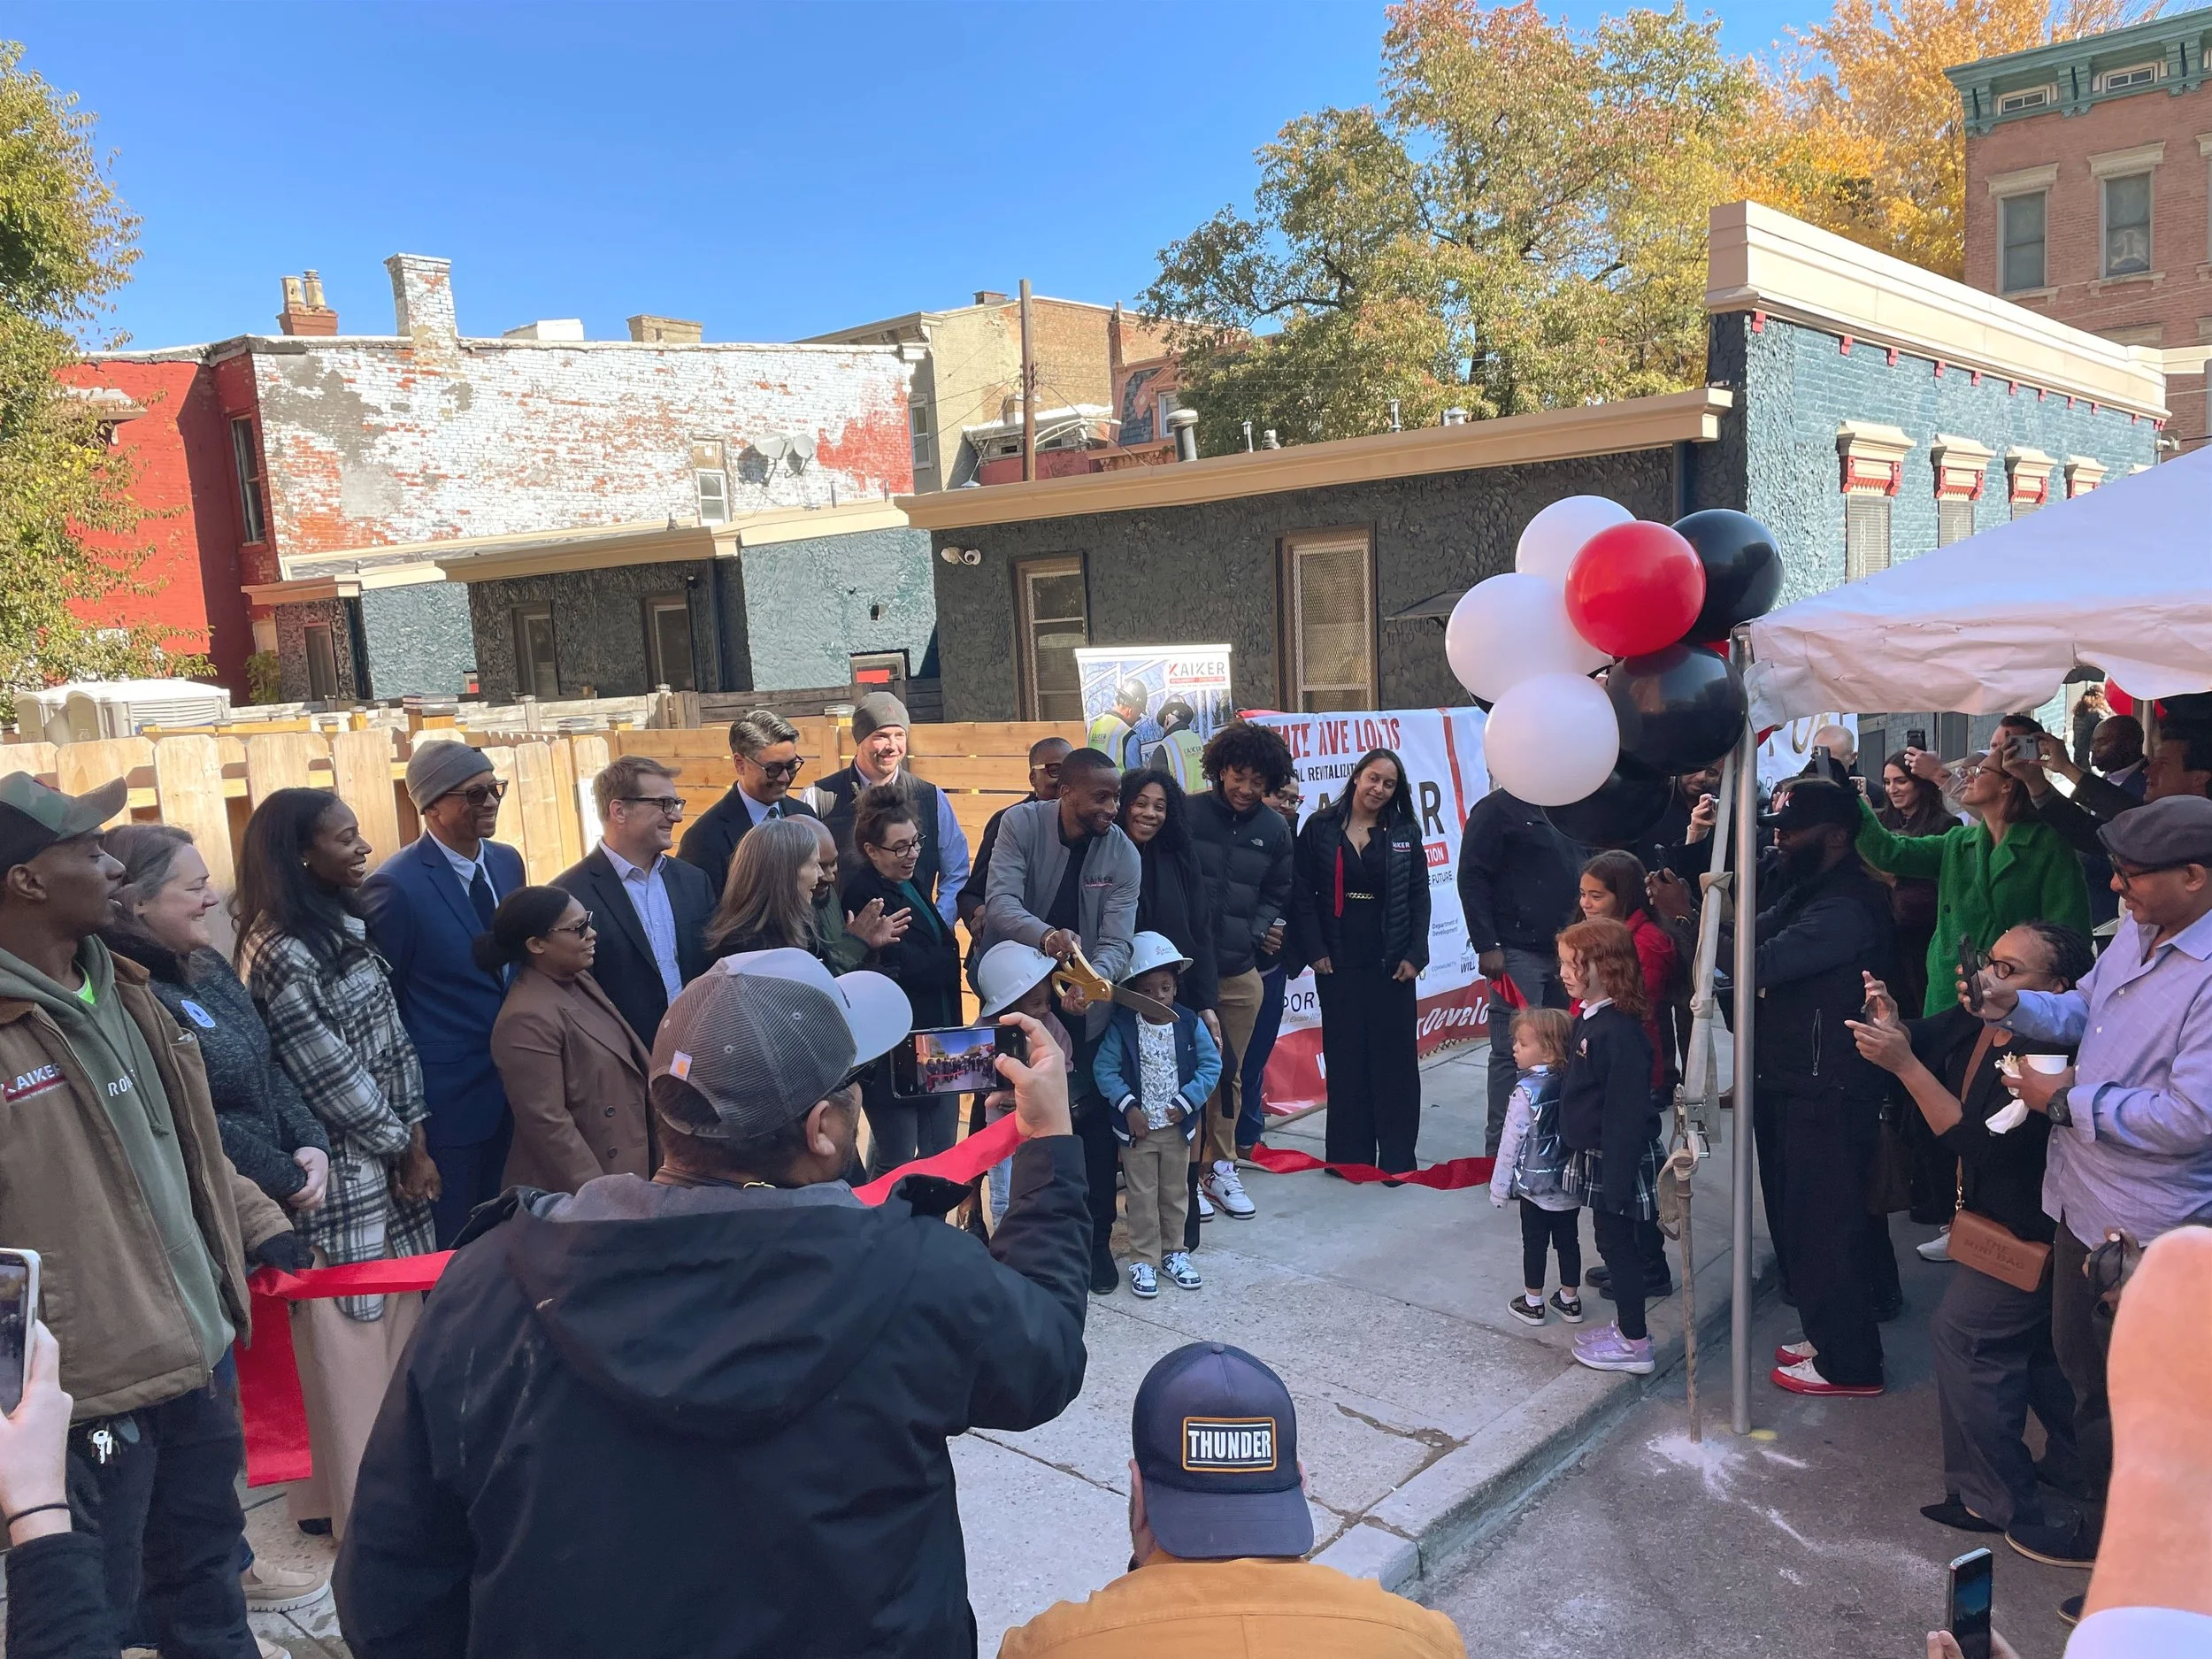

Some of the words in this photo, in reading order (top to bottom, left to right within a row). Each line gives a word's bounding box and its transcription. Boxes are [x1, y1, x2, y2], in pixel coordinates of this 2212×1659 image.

[1169, 662, 1225, 676] KAIKER
[1318, 719, 1349, 757] AVE
[1432, 870, 1453, 884] FUTURE
[1996, 1252, 2025, 1270] BAG
[1187, 1430, 1271, 1459] THUNDER
